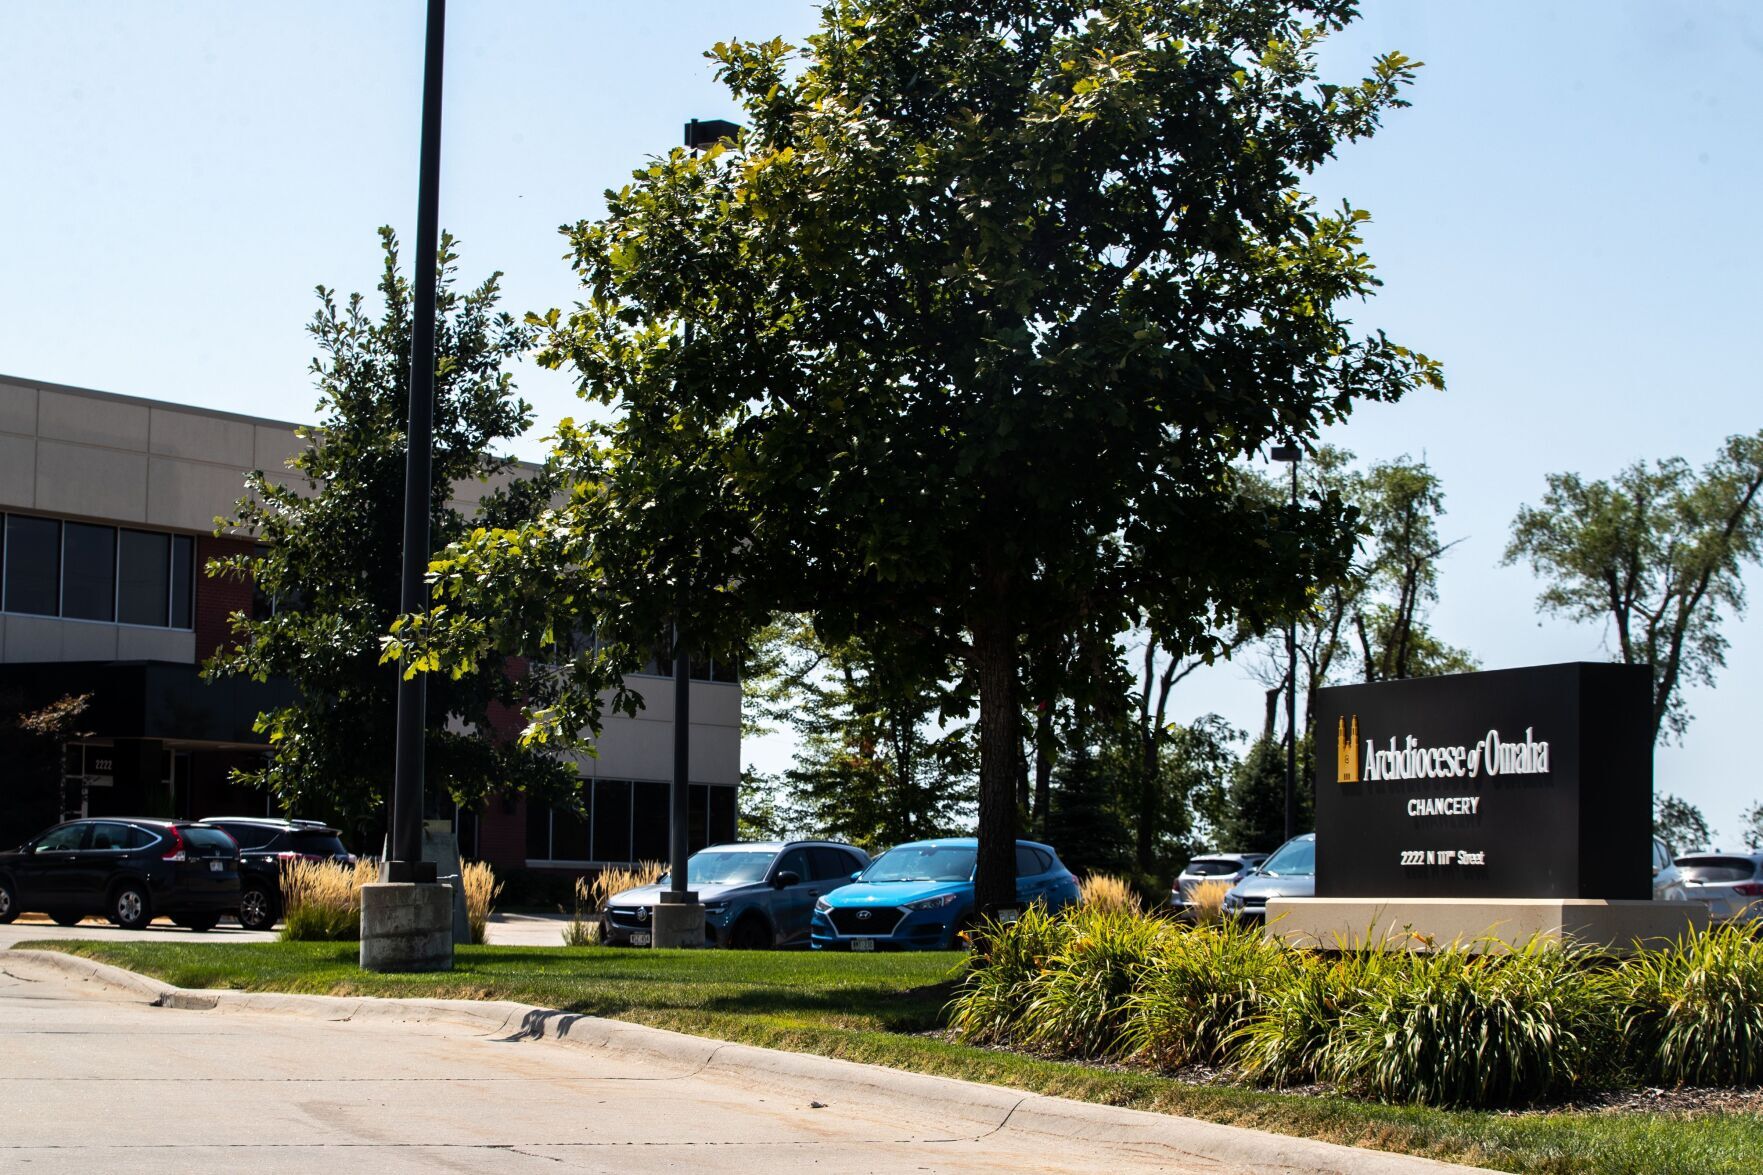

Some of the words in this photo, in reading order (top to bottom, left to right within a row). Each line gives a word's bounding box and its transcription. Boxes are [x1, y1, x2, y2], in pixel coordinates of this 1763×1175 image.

[1363, 735, 1466, 781] Archdiocese
[1467, 741, 1485, 777] of
[1485, 727, 1549, 775] Omaha
[96, 760, 112, 770] 2222
[1408, 797, 1480, 816] CHANCERY
[1401, 850, 1425, 865] 2222
[1427, 851, 1435, 865] N
[1457, 850, 1485, 865] Street
